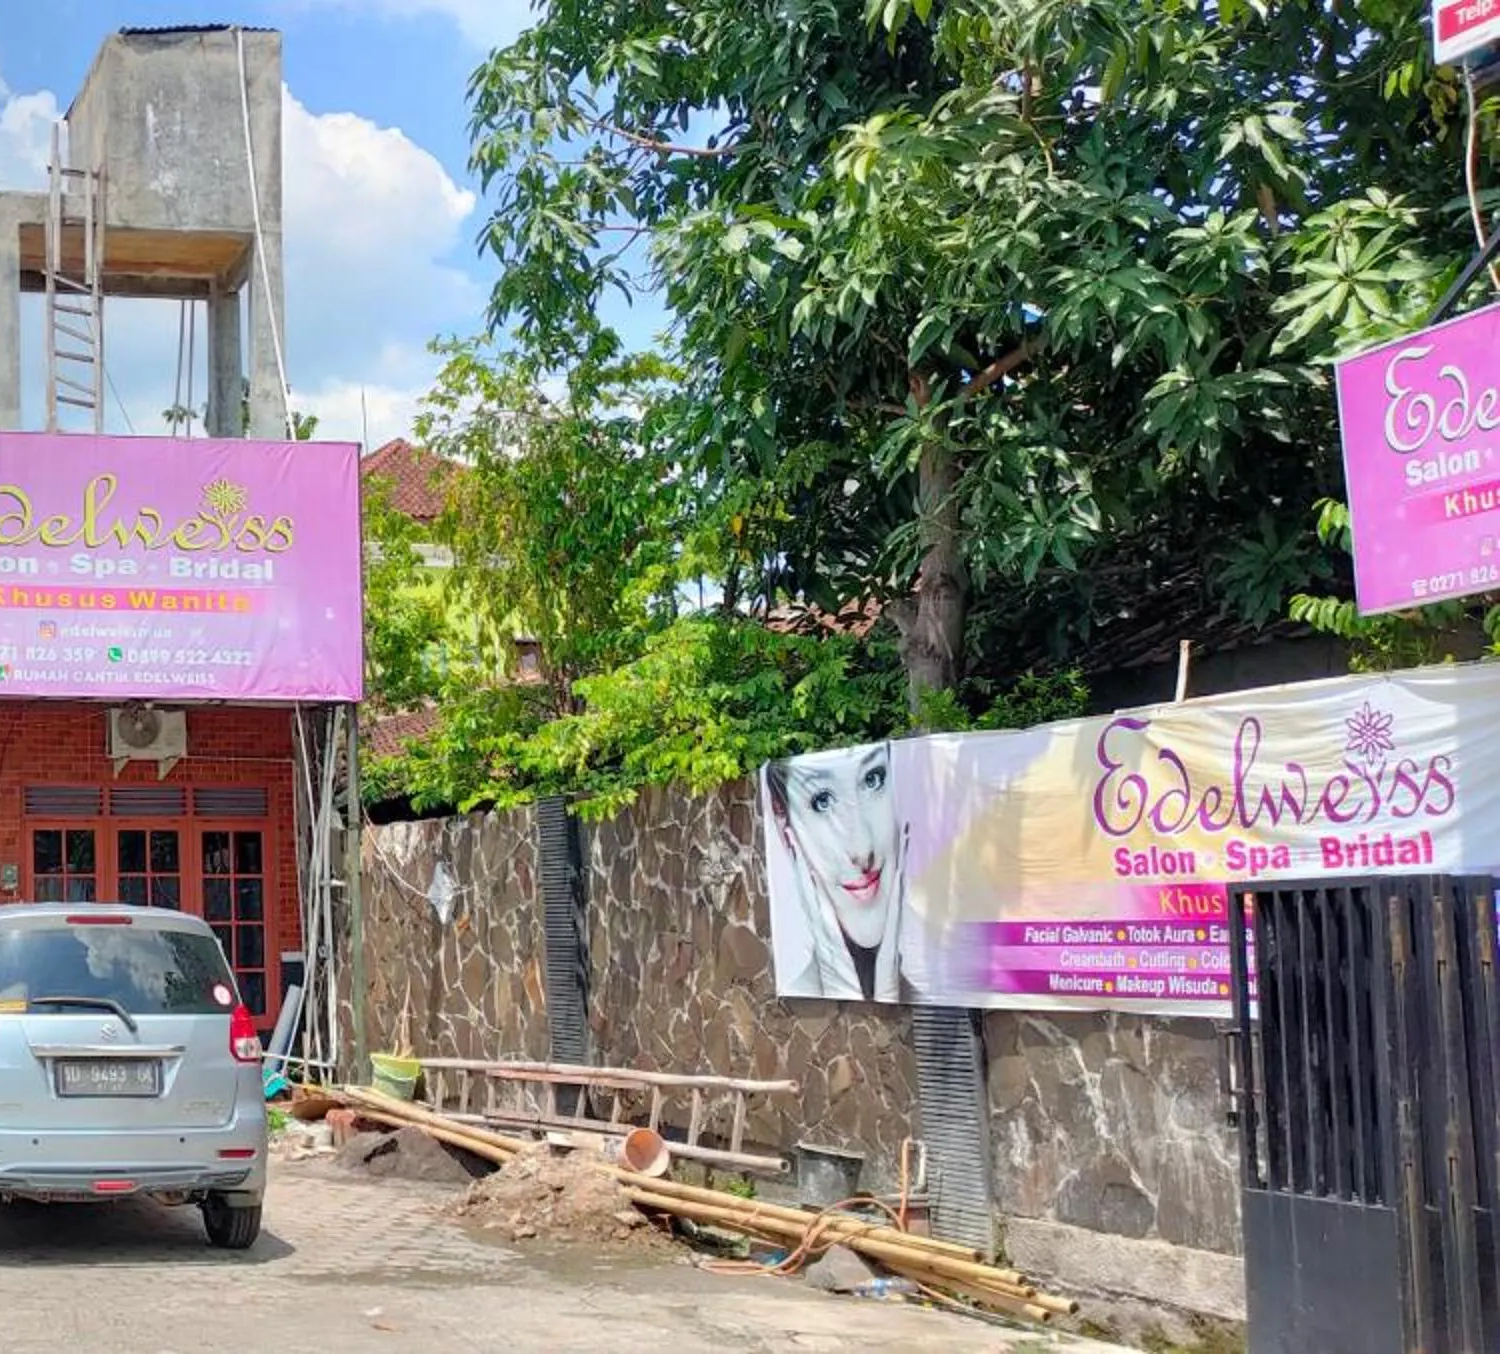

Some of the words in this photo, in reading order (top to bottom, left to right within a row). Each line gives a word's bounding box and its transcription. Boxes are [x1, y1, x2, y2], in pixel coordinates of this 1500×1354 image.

[1405, 449, 1479, 485] Salon
[70, 553, 137, 579] Spa
[169, 557, 274, 581] Bridal
[129, 589, 253, 612] Wanita
[13, 669, 69, 683] RUMAH
[1114, 846, 1196, 877] Salon
[1225, 840, 1291, 876] Spa
[1319, 831, 1433, 869] Bridal
[1024, 926, 1061, 943] Facial
[1063, 926, 1113, 943] Galvanic
[1127, 926, 1161, 943] Totok
[1164, 926, 1195, 943] Aura
[1115, 975, 1164, 995] Makeup
[1168, 976, 1217, 995] Wisuda
